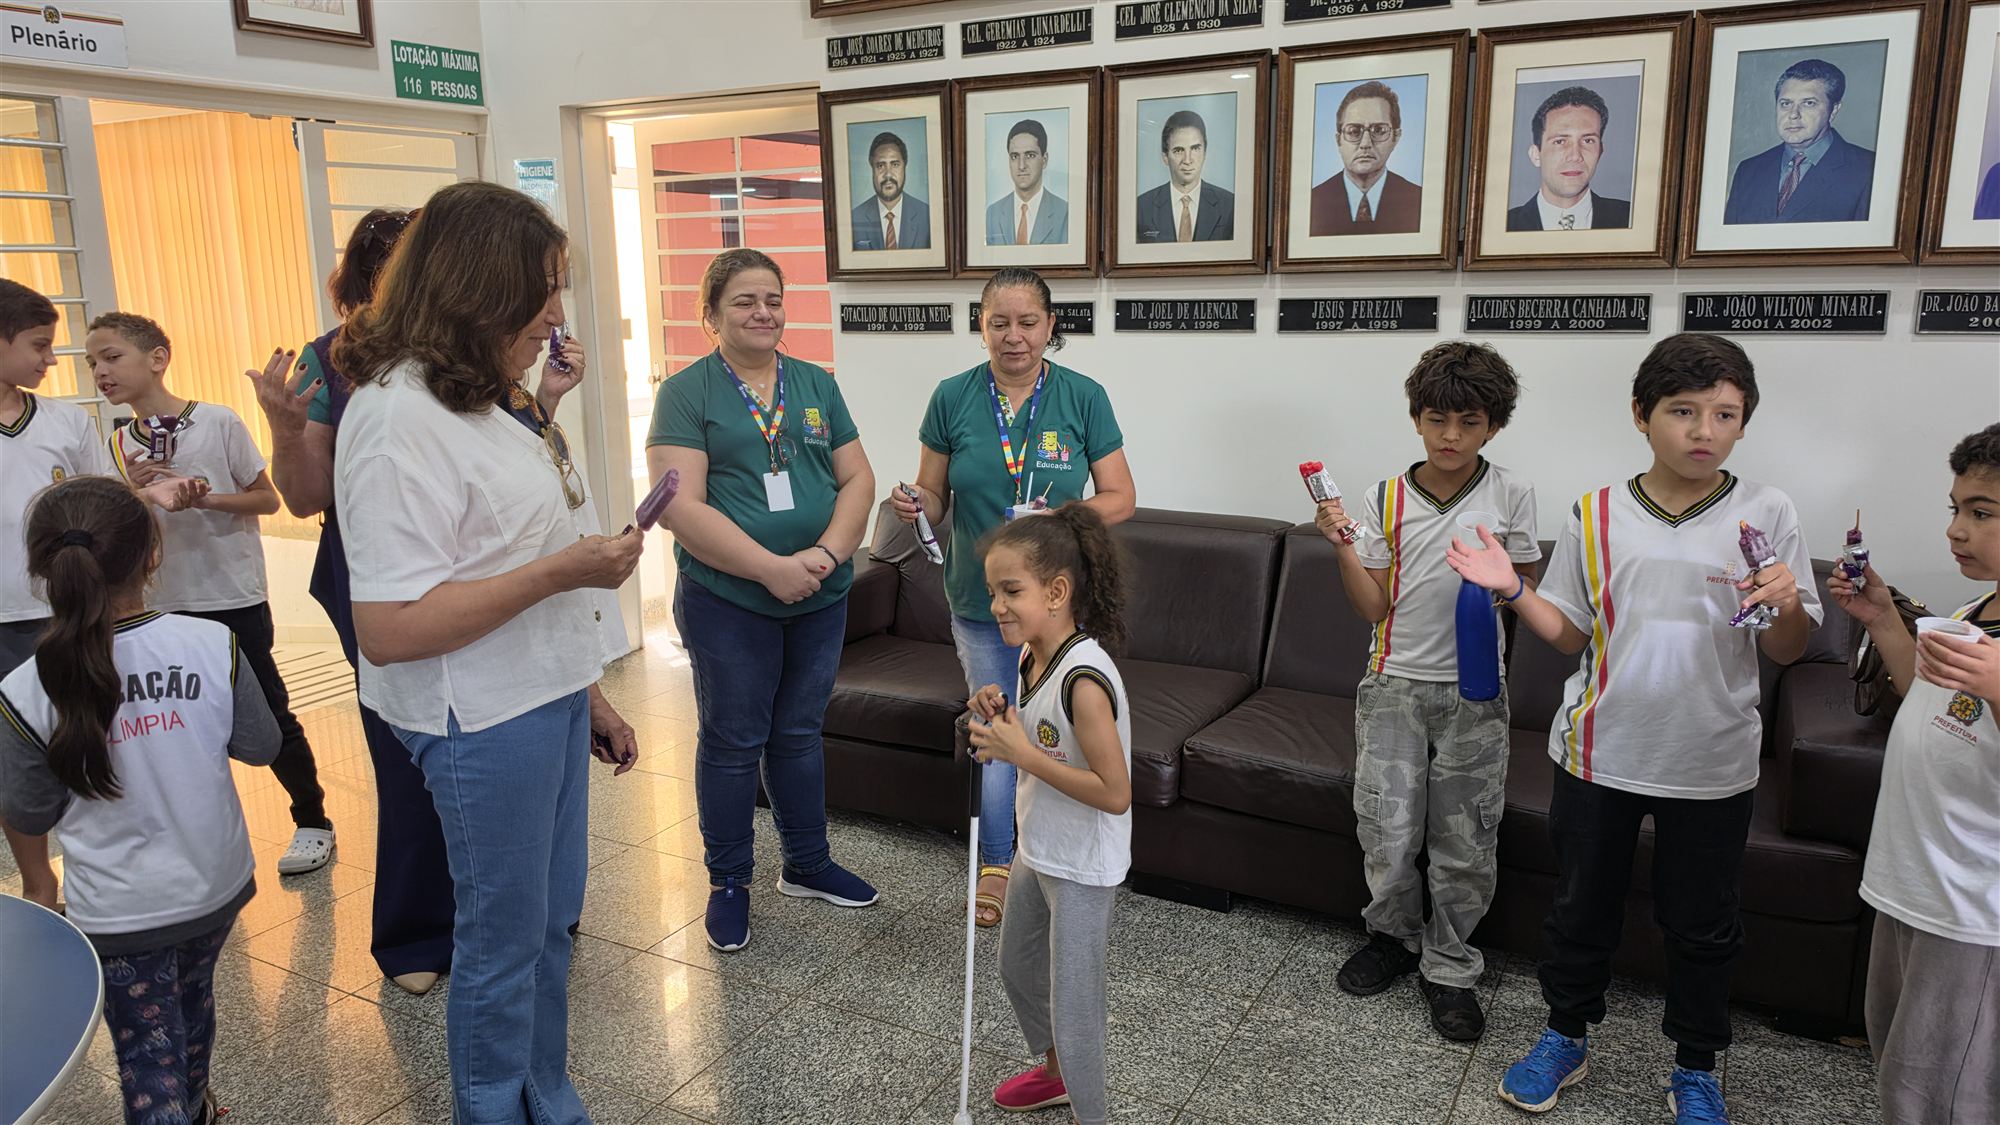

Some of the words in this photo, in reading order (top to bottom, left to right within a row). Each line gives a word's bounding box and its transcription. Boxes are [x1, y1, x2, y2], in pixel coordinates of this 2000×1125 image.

[1140, 2, 1161, 25] JOSÉ
[1218, 0, 1229, 17] DA
[1233, 0, 1258, 15] SILVA
[1327, 4, 1355, 16] 1936
[1360, 3, 1369, 12] A
[1376, 0, 1404, 11] 1937
[985, 19, 1026, 42] GEREMIAS
[1031, 11, 1086, 37] LUNARDELLI
[1152, 23, 1176, 34] 1928
[1182, 22, 1190, 31] A
[1196, 19, 1221, 30] 1930
[11, 24, 98, 53] Plenário
[847, 36, 864, 56] JOSÉ
[866, 34, 892, 54] SOARES
[894, 33, 904, 51] DE
[906, 28, 941, 50] MEDEIROS
[996, 40, 1018, 50] 1922
[1021, 40, 1028, 48] A
[1034, 36, 1055, 46] 1924
[393, 45, 438, 70] LOTAÇÃO
[441, 49, 479, 73] MÁXIMA
[851, 57, 858, 65] A
[860, 55, 877, 64] 1921
[887, 51, 906, 61] 1925
[910, 51, 916, 59] A
[919, 48, 938, 58] 1927
[403, 76, 422, 95] 116
[430, 80, 478, 100] PESSOAS
[519, 165, 554, 177] HIGIENE
[1131, 302, 1147, 320] DR.
[1149, 302, 1173, 320] JOEL
[1177, 302, 1189, 319] DE
[1192, 302, 1238, 320] ALENCAR
[1312, 301, 1345, 319] JESUS
[1469, 299, 1516, 319] ALCIDES
[1518, 298, 1569, 319] BECERRA
[1572, 298, 1627, 318] CANHADA
[1696, 297, 1718, 317] DR.
[1723, 294, 1757, 317] JOÃO
[1763, 296, 1814, 317] WILTON
[1820, 295, 1876, 317] MINARI
[1924, 295, 1944, 312] DR.
[1947, 293, 1979, 312] JOÃO
[1984, 295, 1999, 312] BA
[843, 306, 877, 322] OTACILIO
[879, 307, 888, 322] DE
[889, 306, 927, 322] OLIVEIRA
[929, 306, 949, 323] NETO
[1067, 308, 1091, 317] SALATA
[867, 323, 886, 331] 1991
[904, 323, 925, 331] 1992
[1148, 321, 1172, 330] 1995
[1179, 322, 1187, 330] A
[1194, 321, 1220, 330] 1996
[1315, 321, 1343, 330] 1997
[1352, 322, 1359, 330] A
[1368, 320, 1398, 330] 1998
[1509, 319, 1542, 329] 1999
[1551, 320, 1560, 329] A
[1568, 319, 1606, 329] 2000
[1731, 318, 1769, 329] 2001
[1774, 319, 1785, 329] A
[1790, 318, 1833, 329] 2002
[1036, 460, 1072, 471] Educação
[120, 665, 201, 703] AÇÃO
[106, 710, 185, 745] LÍMPIA
[1933, 715, 1978, 744] PREFEITURA
